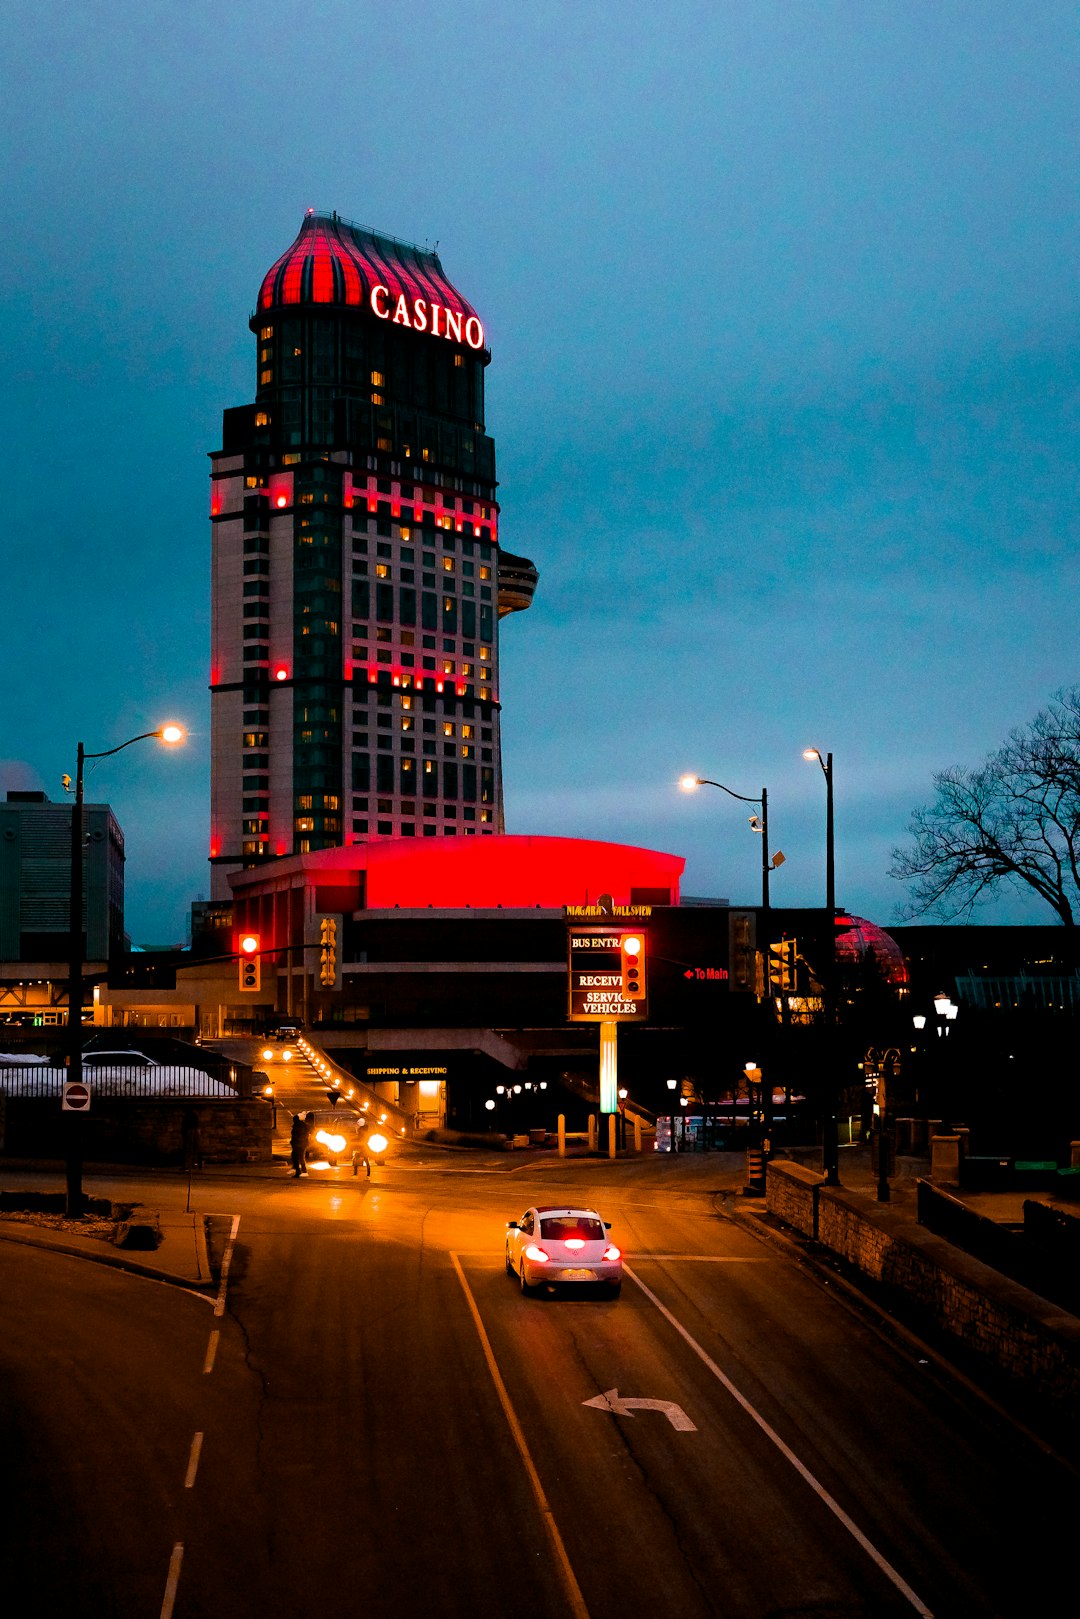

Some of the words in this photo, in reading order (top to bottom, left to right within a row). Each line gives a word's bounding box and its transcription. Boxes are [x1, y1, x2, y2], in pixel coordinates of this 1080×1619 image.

[371, 285, 484, 349] CASINO
[566, 905, 602, 917] NIAGARA
[612, 905, 652, 917] FALLSVIEW
[572, 939, 590, 948] BUS
[694, 968, 706, 980] To
[706, 968, 728, 980] Main
[583, 1003, 637, 1014] VEHICLES
